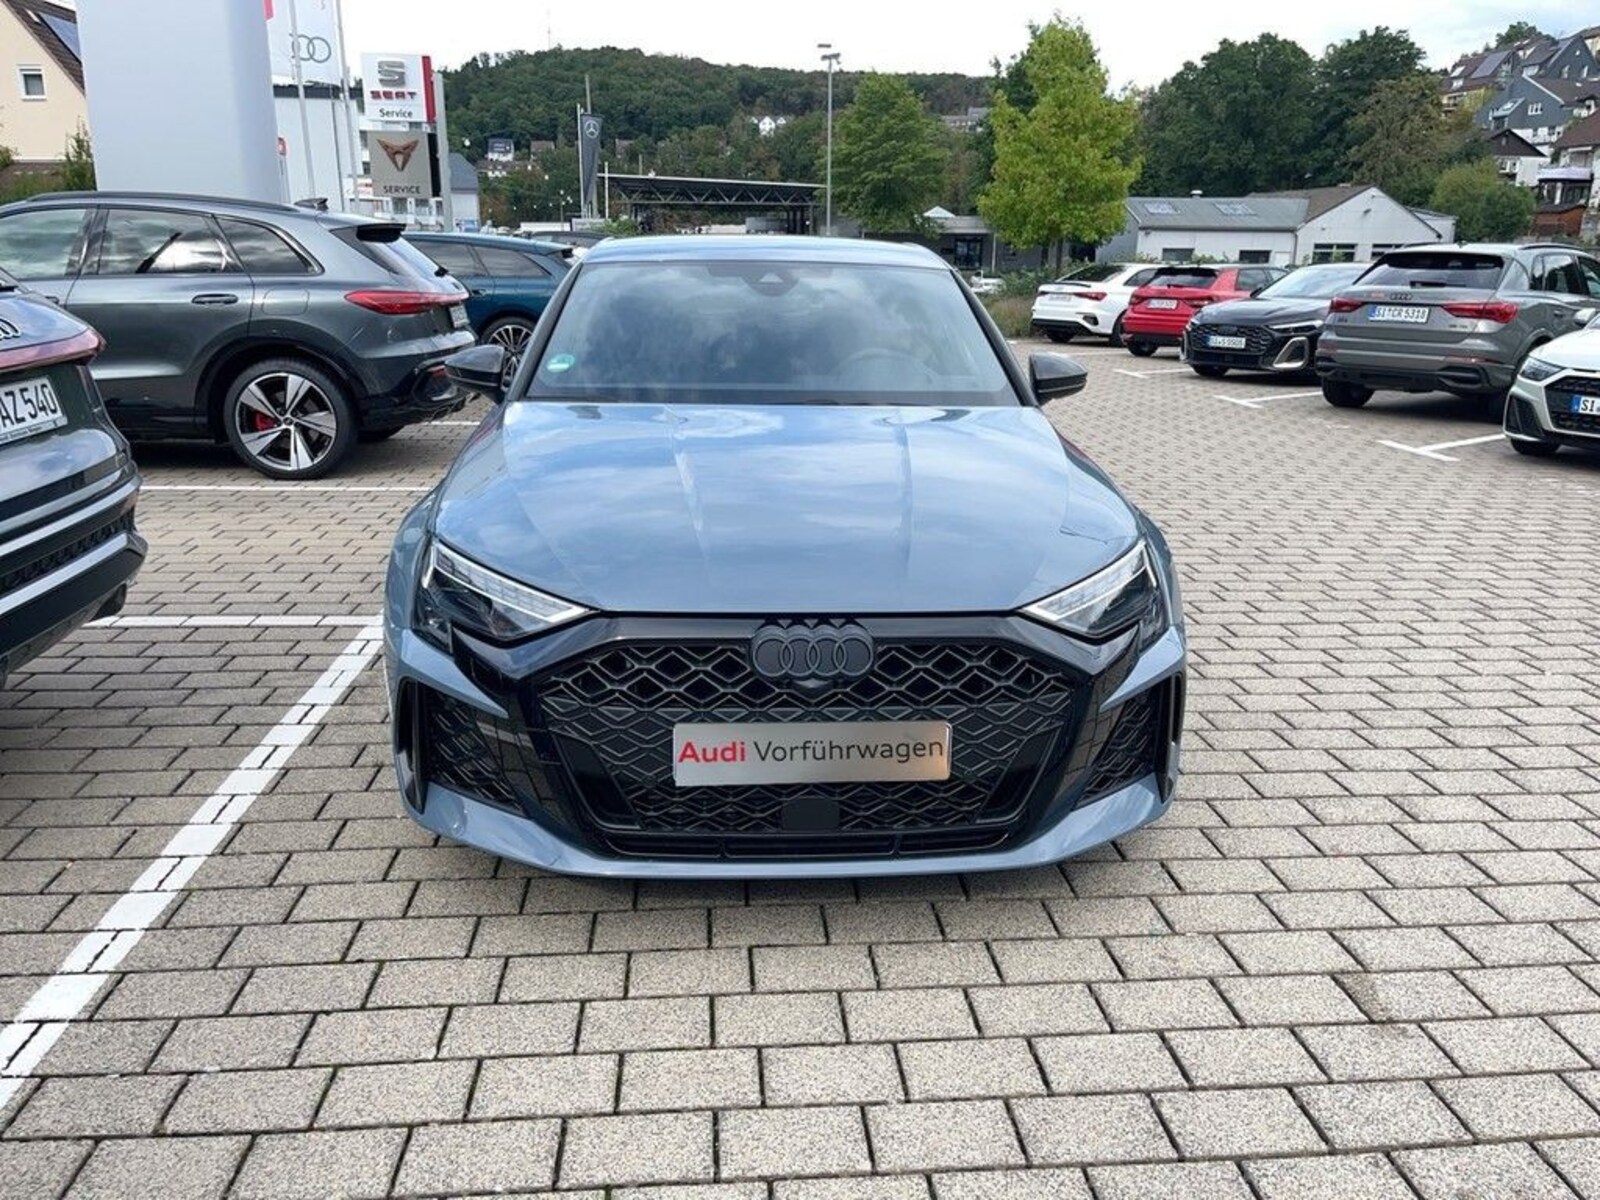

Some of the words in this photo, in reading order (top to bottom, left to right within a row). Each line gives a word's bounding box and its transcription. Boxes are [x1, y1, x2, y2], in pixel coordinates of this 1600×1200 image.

[370, 90, 417, 100] SEAT
[379, 108, 413, 118] Service
[384, 185, 421, 194] SERVICE
[19, 383, 58, 419] 540
[1581, 399, 1595, 412] SI
[678, 741, 746, 763] Audi
[754, 739, 944, 764] Vorführwagen
